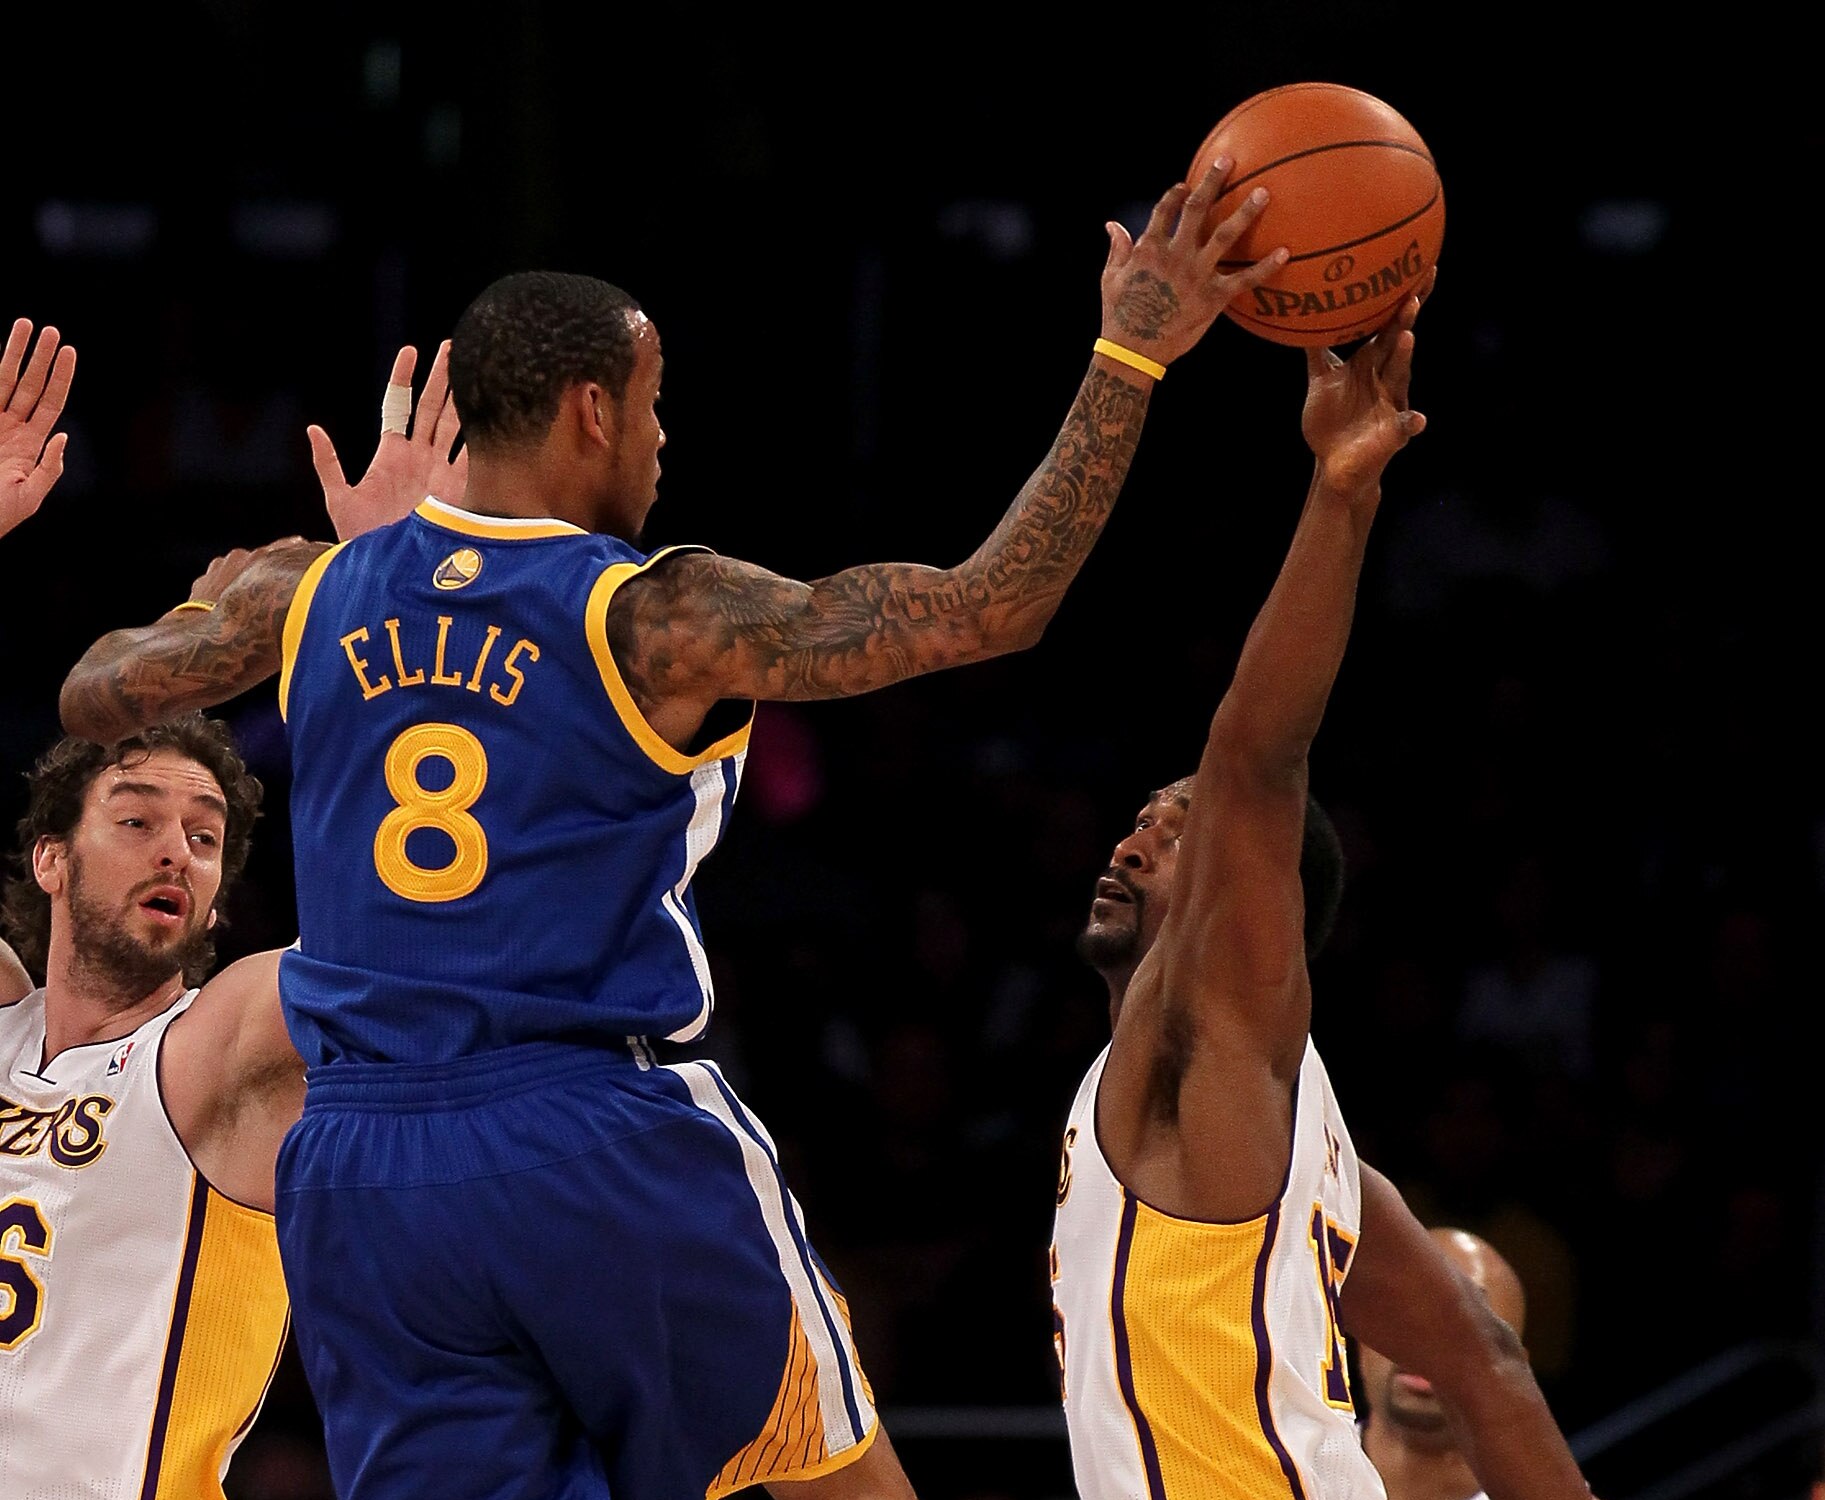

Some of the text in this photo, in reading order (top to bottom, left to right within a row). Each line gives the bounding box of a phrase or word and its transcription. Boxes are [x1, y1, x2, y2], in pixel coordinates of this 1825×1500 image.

[1253, 239, 1421, 317] SPALDING
[339, 615, 541, 707] ELLIS
[374, 722, 488, 902] 8
